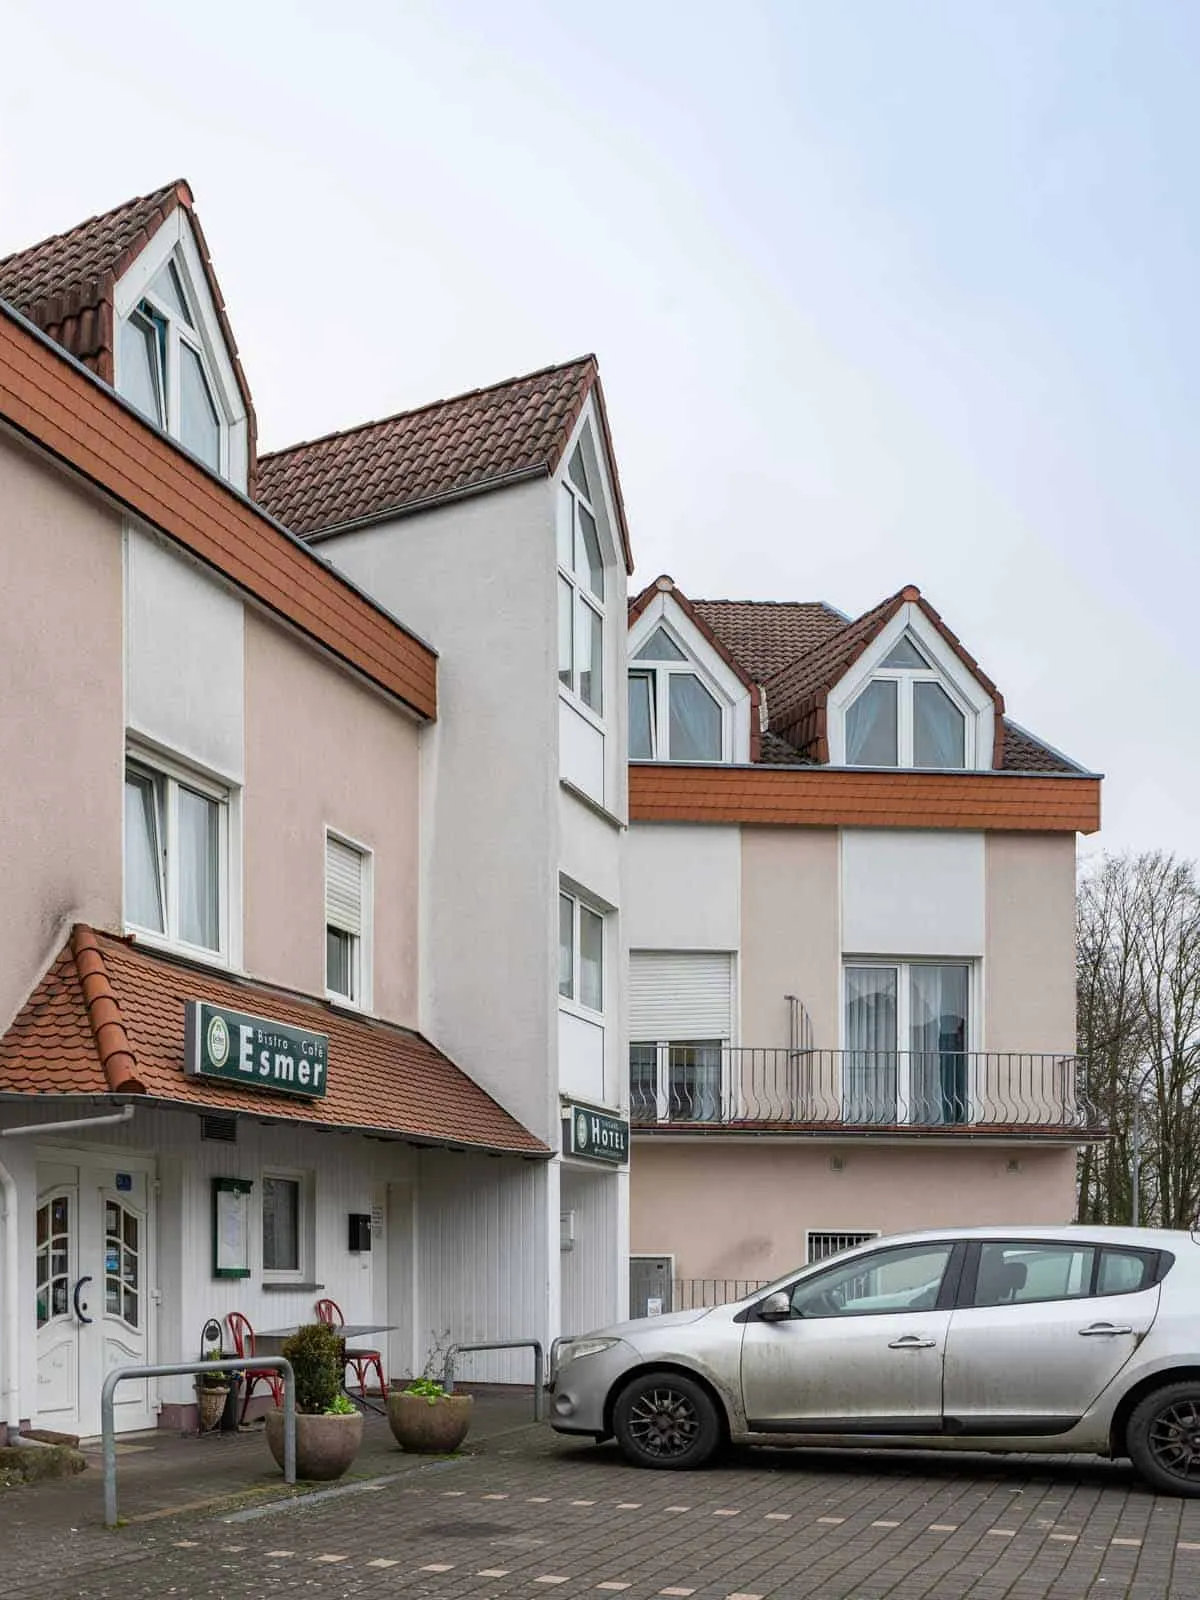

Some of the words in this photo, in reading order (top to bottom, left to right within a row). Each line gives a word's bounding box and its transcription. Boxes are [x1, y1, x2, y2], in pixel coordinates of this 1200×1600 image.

[239, 1024, 323, 1087] Esmer
[258, 1029, 288, 1049] Bistro
[591, 1117, 624, 1150] HOTEL
